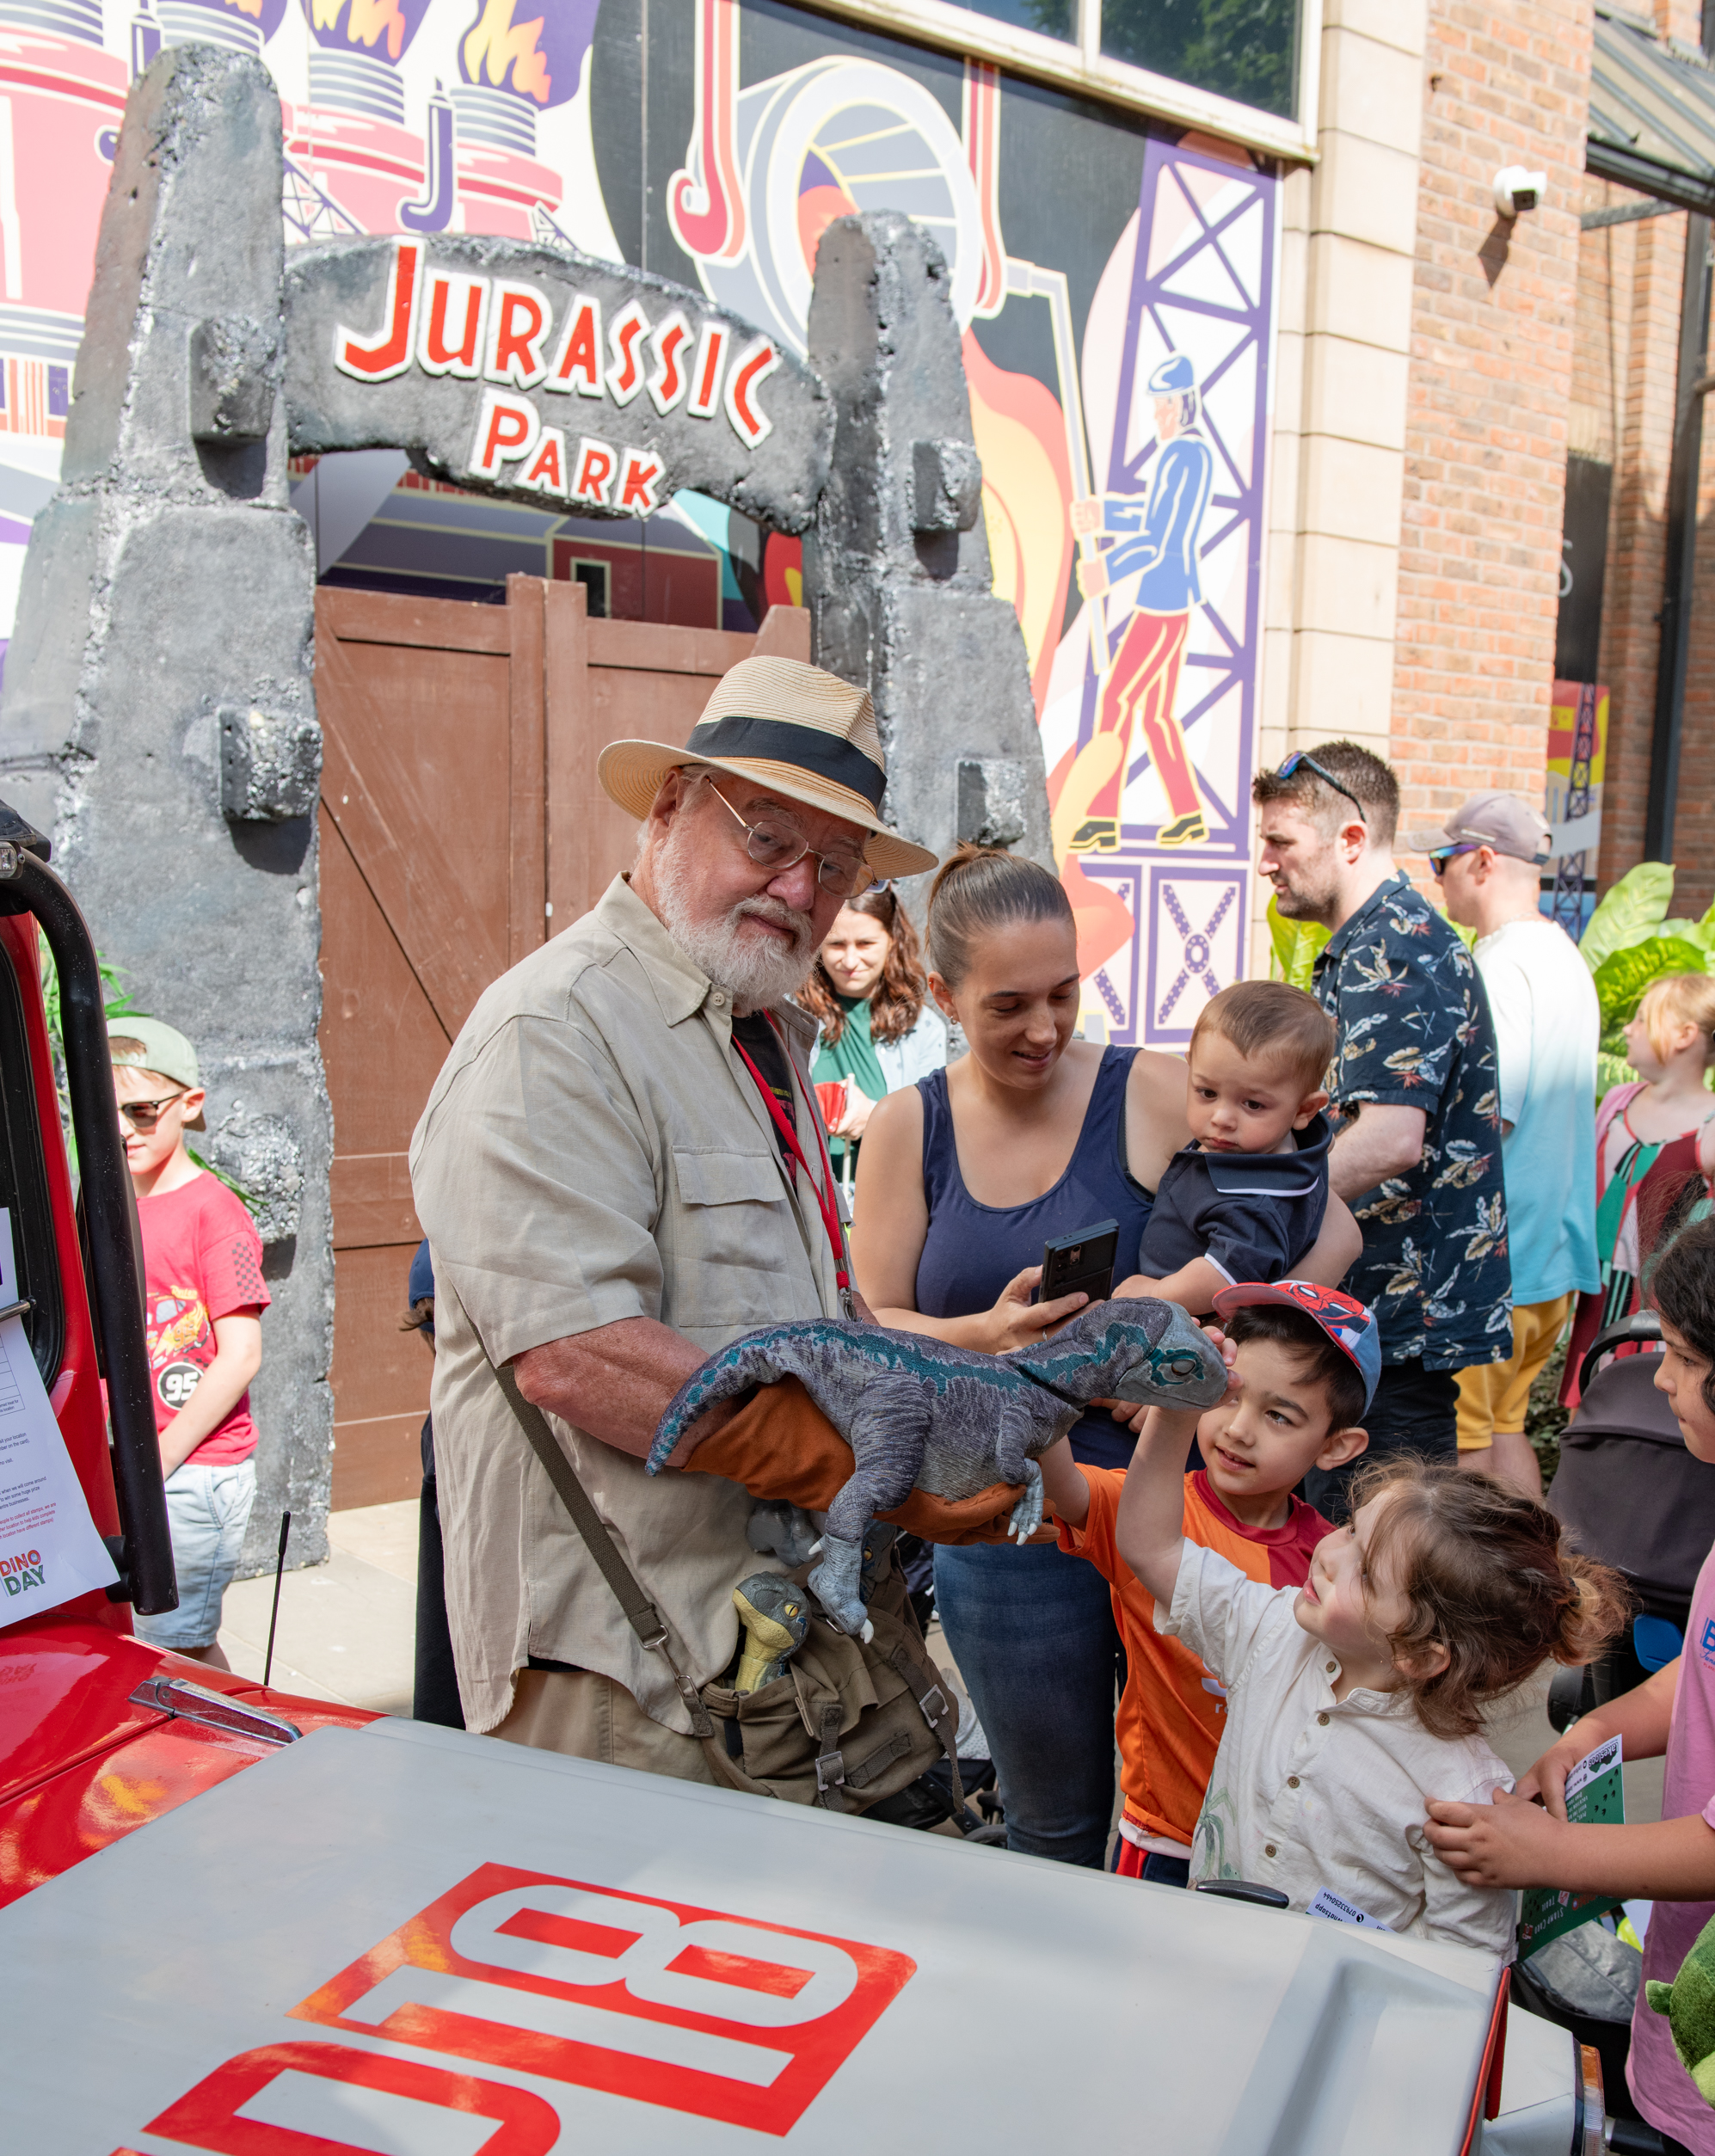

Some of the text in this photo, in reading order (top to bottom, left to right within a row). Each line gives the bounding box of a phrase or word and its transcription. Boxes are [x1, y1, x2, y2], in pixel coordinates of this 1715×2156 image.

[335, 236, 782, 450] JURASSIC
[470, 387, 666, 515] PARK
[166, 1372, 199, 1402] 95
[0, 1549, 41, 1577] DINO
[3, 1564, 46, 1596] DAY
